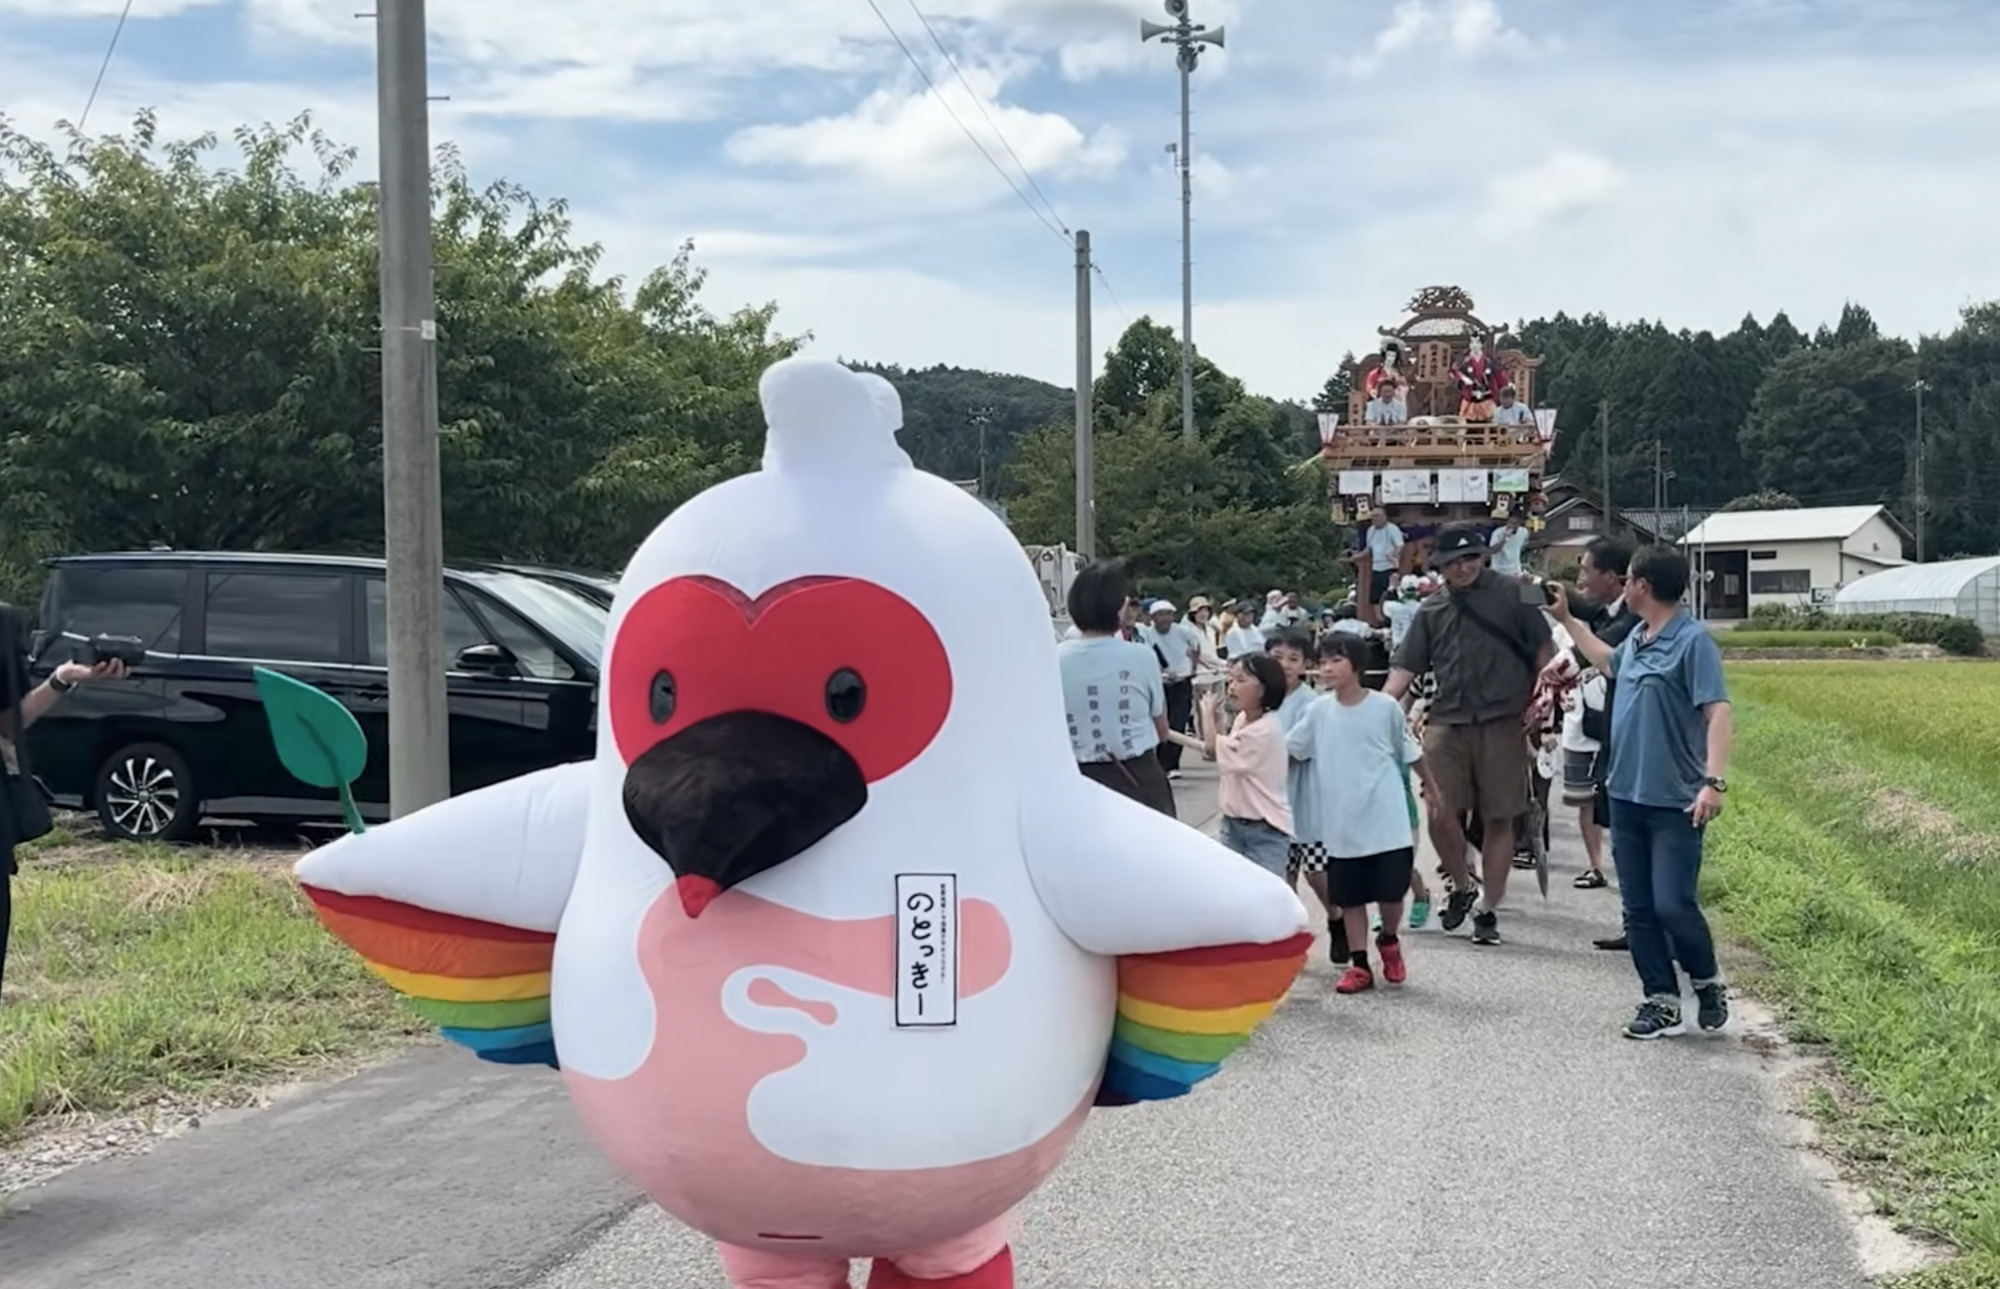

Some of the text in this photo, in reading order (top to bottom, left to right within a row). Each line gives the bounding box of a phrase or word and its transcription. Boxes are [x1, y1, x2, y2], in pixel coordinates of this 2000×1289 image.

[906, 892, 935, 1016] のとっきー
